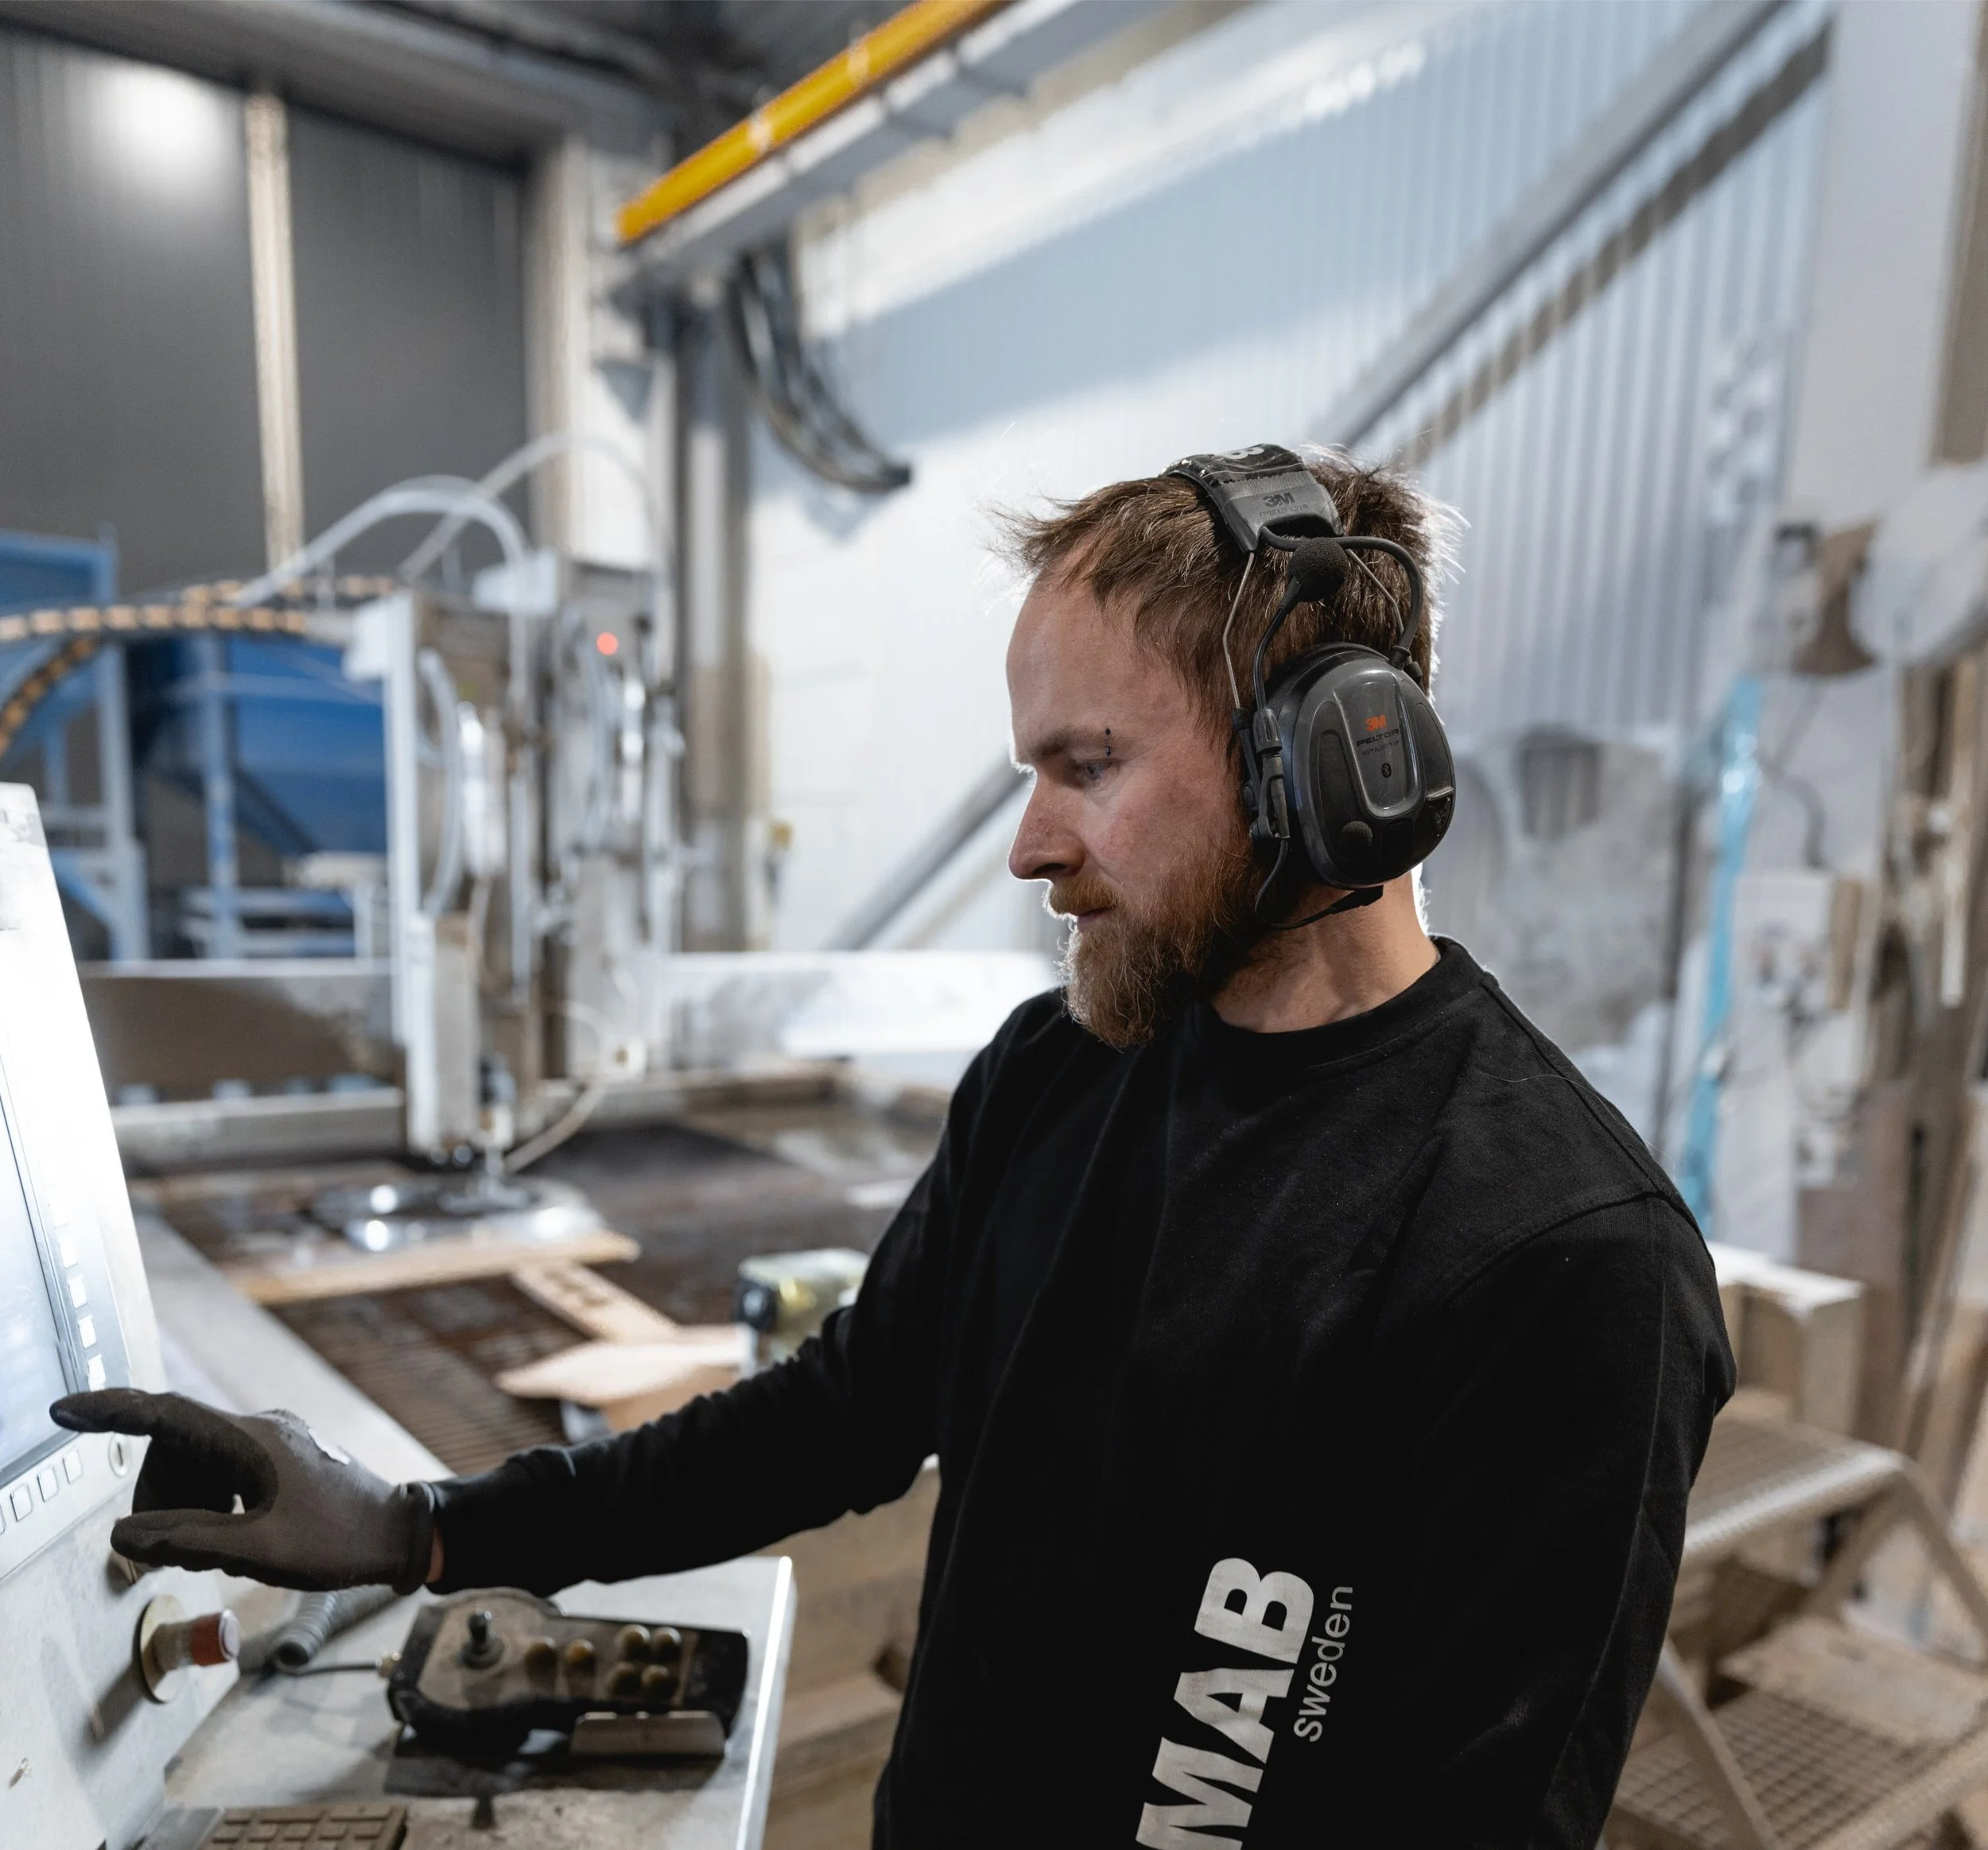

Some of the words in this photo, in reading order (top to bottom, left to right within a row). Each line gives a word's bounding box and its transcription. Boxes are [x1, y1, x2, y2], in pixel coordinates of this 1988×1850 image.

[1263, 492, 1296, 507] 3M
[1364, 714, 1387, 732] 3M
[1357, 729, 1400, 747] PELTOR
[1136, 1557, 1314, 1850] MAB
